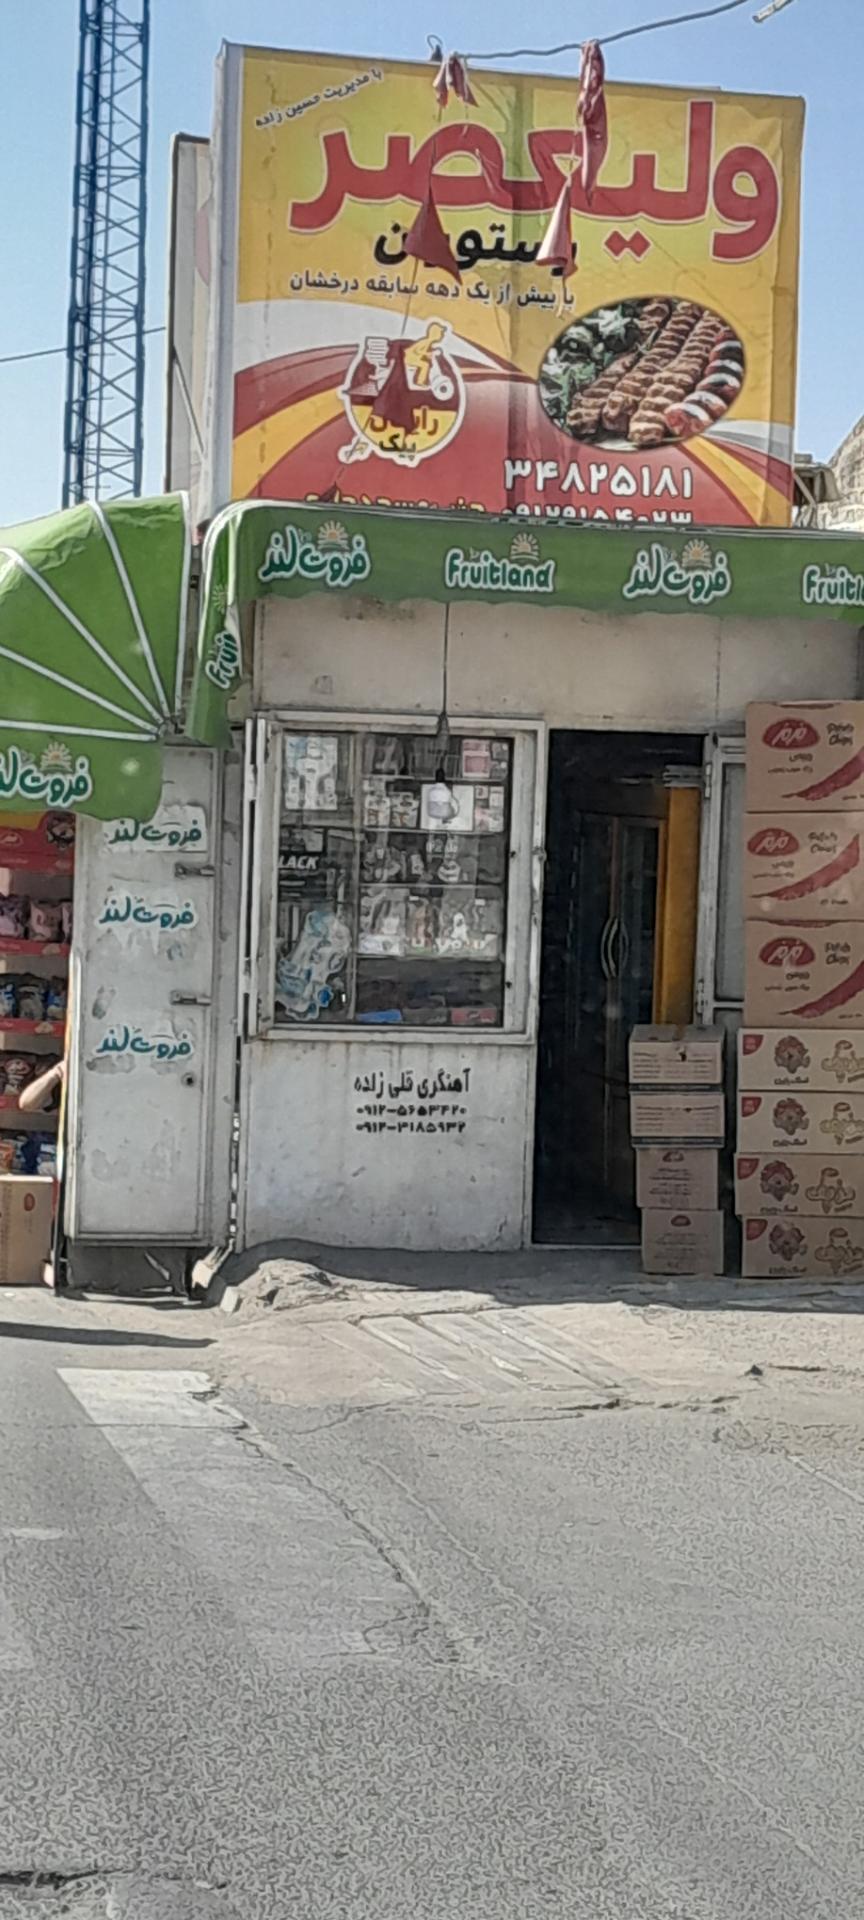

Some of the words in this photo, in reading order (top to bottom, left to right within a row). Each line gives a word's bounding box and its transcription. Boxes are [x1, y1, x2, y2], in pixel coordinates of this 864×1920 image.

[323, 74, 370, 99] مدیریت
[370, 68, 382, 81] با
[255, 107, 283, 127] زاده
[285, 94, 321, 119] حسین
[288, 100, 780, 260] ولیعصر
[374, 223, 578, 277] ستون
[289, 269, 360, 294] درخشان
[365, 275, 419, 299] سابقه
[425, 281, 460, 299] دهه
[466, 282, 491, 305] یک
[496, 284, 511, 305] از
[379, 433, 417, 462] پیک
[504, 459, 692, 499] ۳۴۸۲۵۱۸۱
[446, 549, 555, 591] Fruitland
[803, 565, 864, 606] Fruitl
[277, 855, 320, 870] LACK
[354, 1071, 385, 1099] زاده
[388, 1070, 414, 1099] قلی
[417, 1068, 471, 1099] آهنگری
